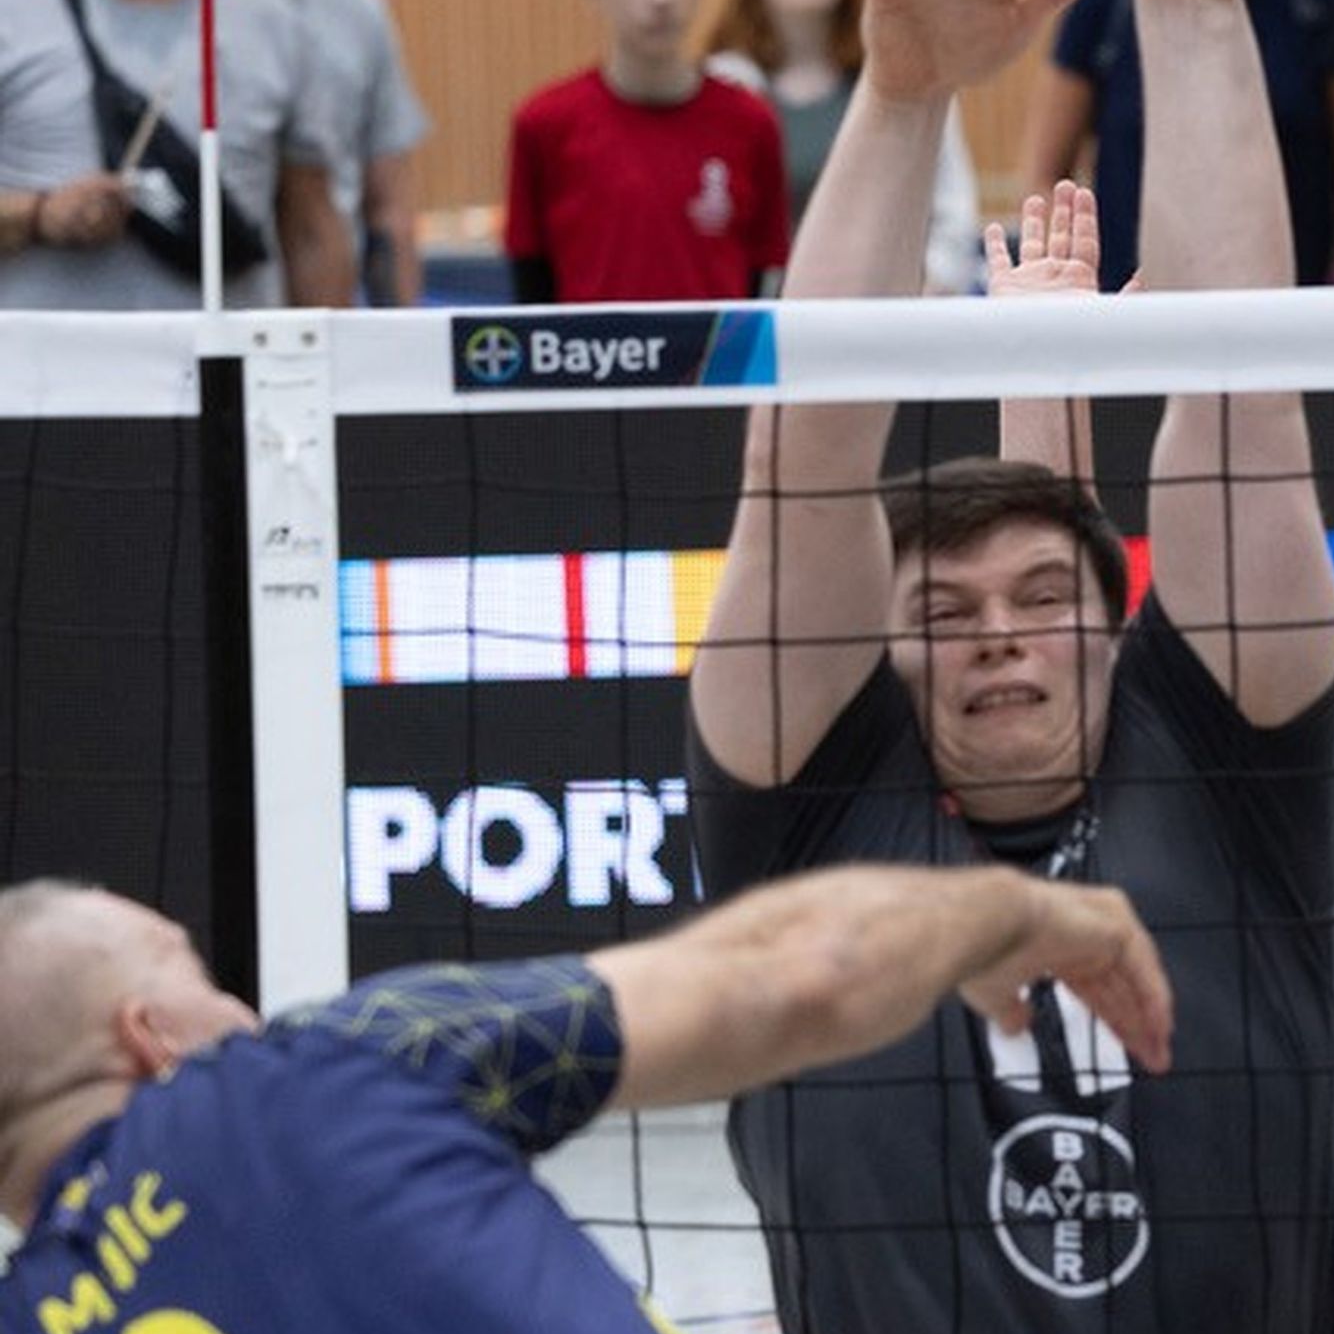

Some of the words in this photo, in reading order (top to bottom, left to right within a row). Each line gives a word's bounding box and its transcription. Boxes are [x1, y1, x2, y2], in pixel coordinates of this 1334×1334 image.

[531, 329, 666, 381] Bayer
[1003, 1178, 1139, 1218] BAYER
[1052, 1130, 1083, 1283] BAYER
